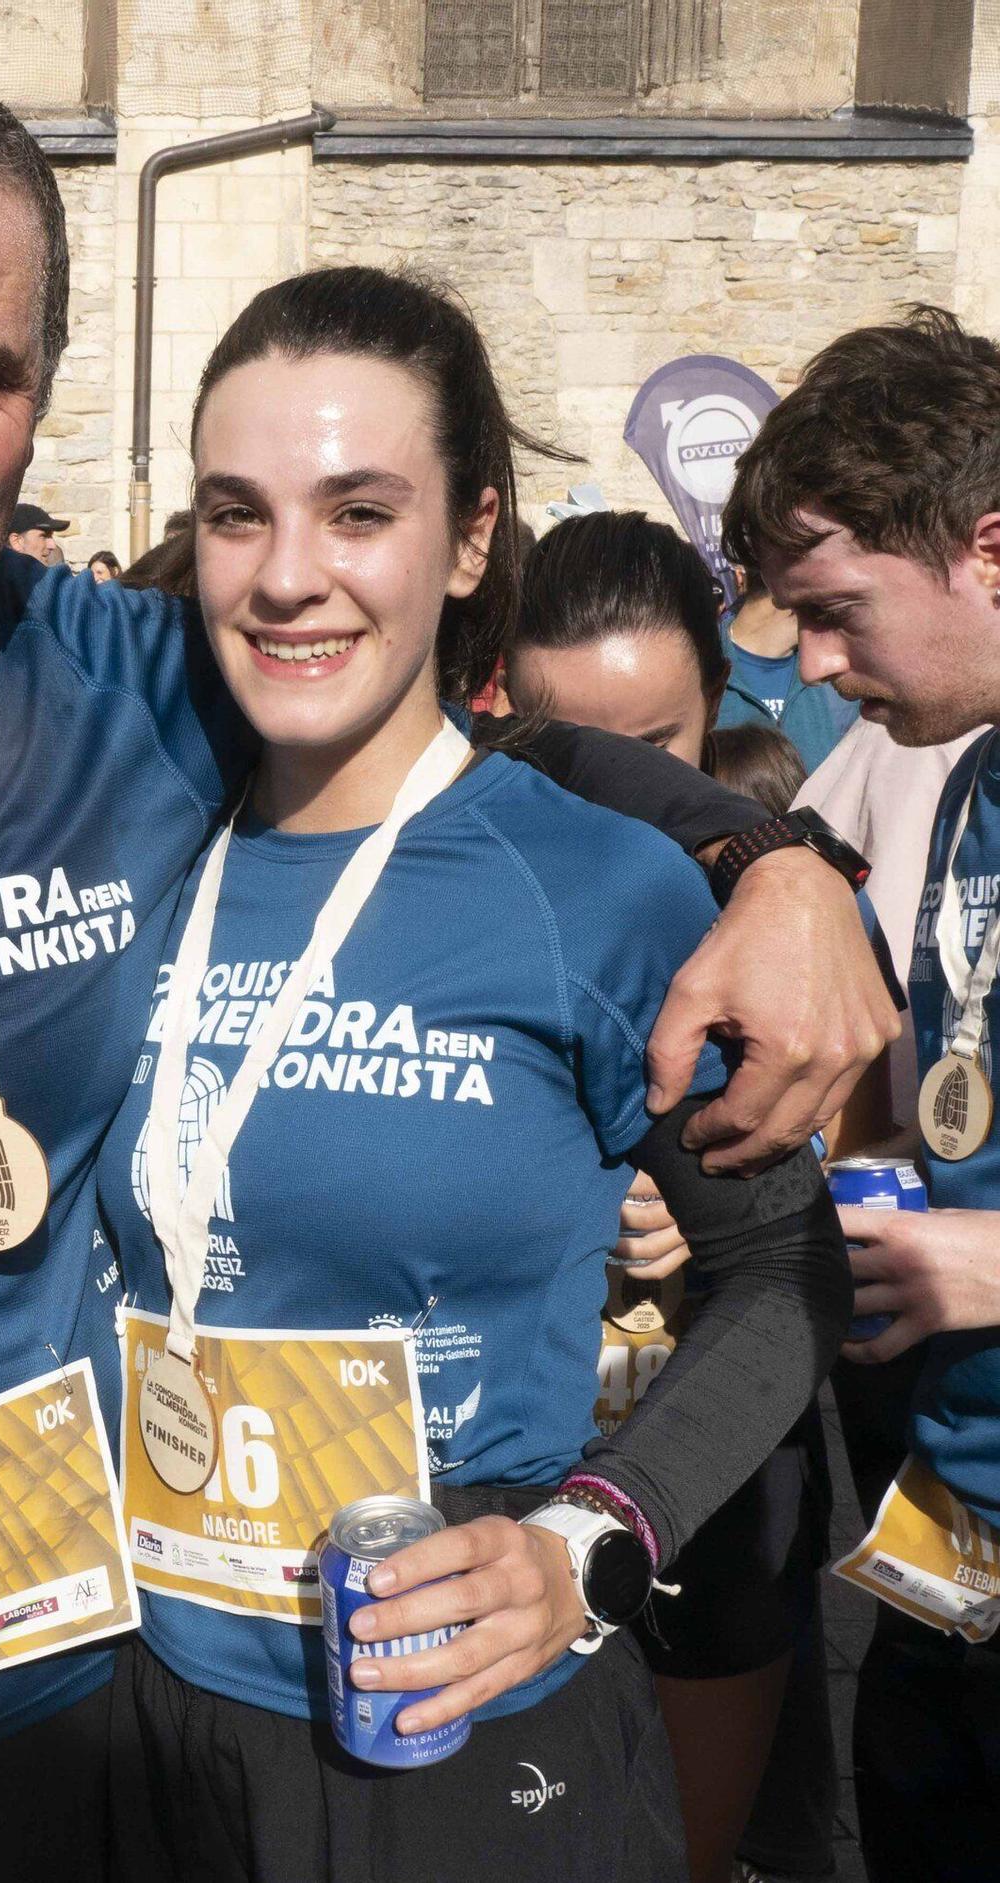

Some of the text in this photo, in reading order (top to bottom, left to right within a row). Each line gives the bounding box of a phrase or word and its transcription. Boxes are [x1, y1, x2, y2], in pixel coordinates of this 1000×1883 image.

[79, 879, 134, 914] REN
[425, 1029, 495, 1062] REN
[208, 1234, 240, 1256] RIA
[416, 1347, 481, 1362] itoria-Gasteizko
[416, 1362, 440, 1374] dala
[338, 1358, 390, 1388] 10K
[155, 1382, 188, 1409] CONQUISTA
[156, 1392, 199, 1425] ALMENDRA
[34, 1396, 76, 1435] 10K
[178, 1415, 209, 1440] KONKISTA
[146, 1419, 207, 1467] FINISHER
[202, 1513, 281, 1545] NAGORE
[292, 1567, 319, 1577] LABO
[3, 1601, 44, 1622] LABORAL
[394, 1738, 417, 1747] CON
[420, 1728, 449, 1745] SALES
[511, 1781, 566, 1810] spyro
